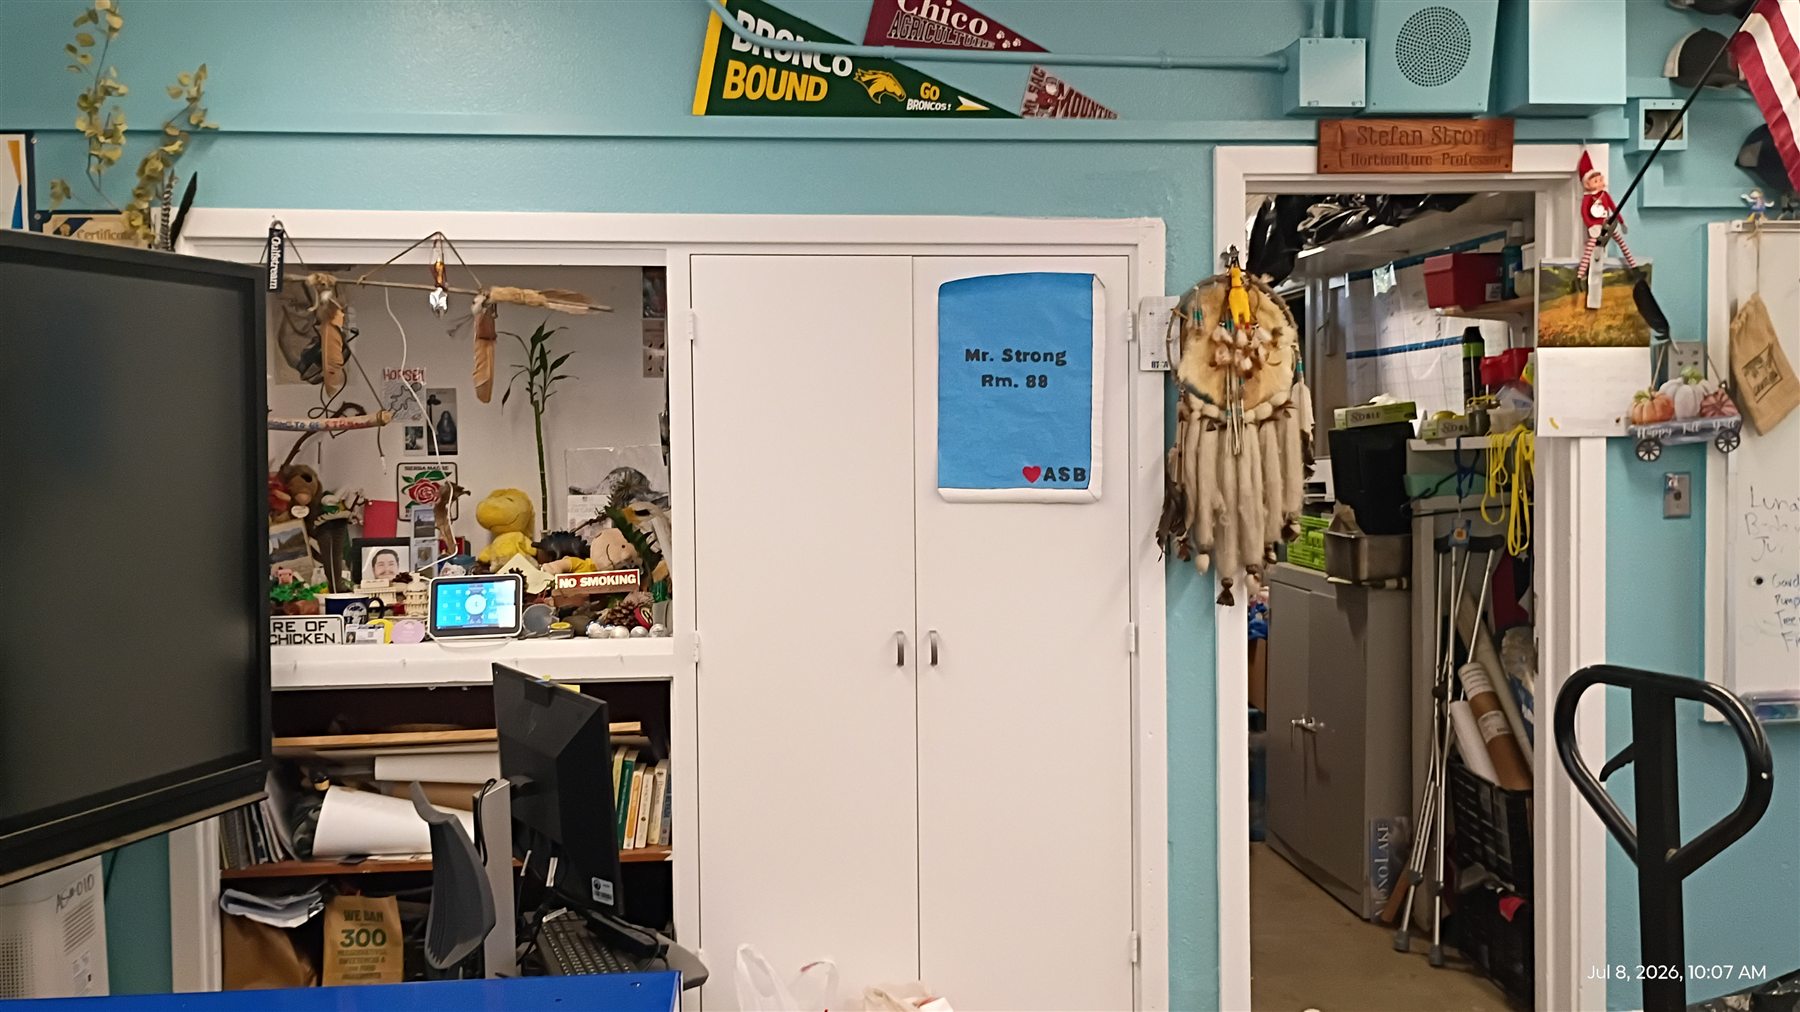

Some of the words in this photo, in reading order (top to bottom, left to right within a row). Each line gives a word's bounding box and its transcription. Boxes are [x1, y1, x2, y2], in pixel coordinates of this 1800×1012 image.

[897, 0, 988, 36] Chico
[731, 9, 853, 77] BRONCO
[722, 59, 828, 102] BOUND
[920, 82, 940, 101] GO
[1357, 125, 1423, 146] Stefan
[1431, 125, 1499, 150] Strong
[1351, 152, 1433, 167] Horticulture
[1441, 152, 1505, 166] Professor
[965, 349, 994, 362] Mr.
[1001, 348, 1067, 366] Strong
[981, 374, 1019, 388] Rm.
[1026, 374, 1048, 388] 88
[1043, 467, 1087, 482] ASB
[559, 578, 577, 589] NO
[580, 574, 637, 587] SMOKING
[305, 621, 328, 632] OF
[270, 633, 336, 645] CHICKEN
[340, 928, 387, 948] 300
